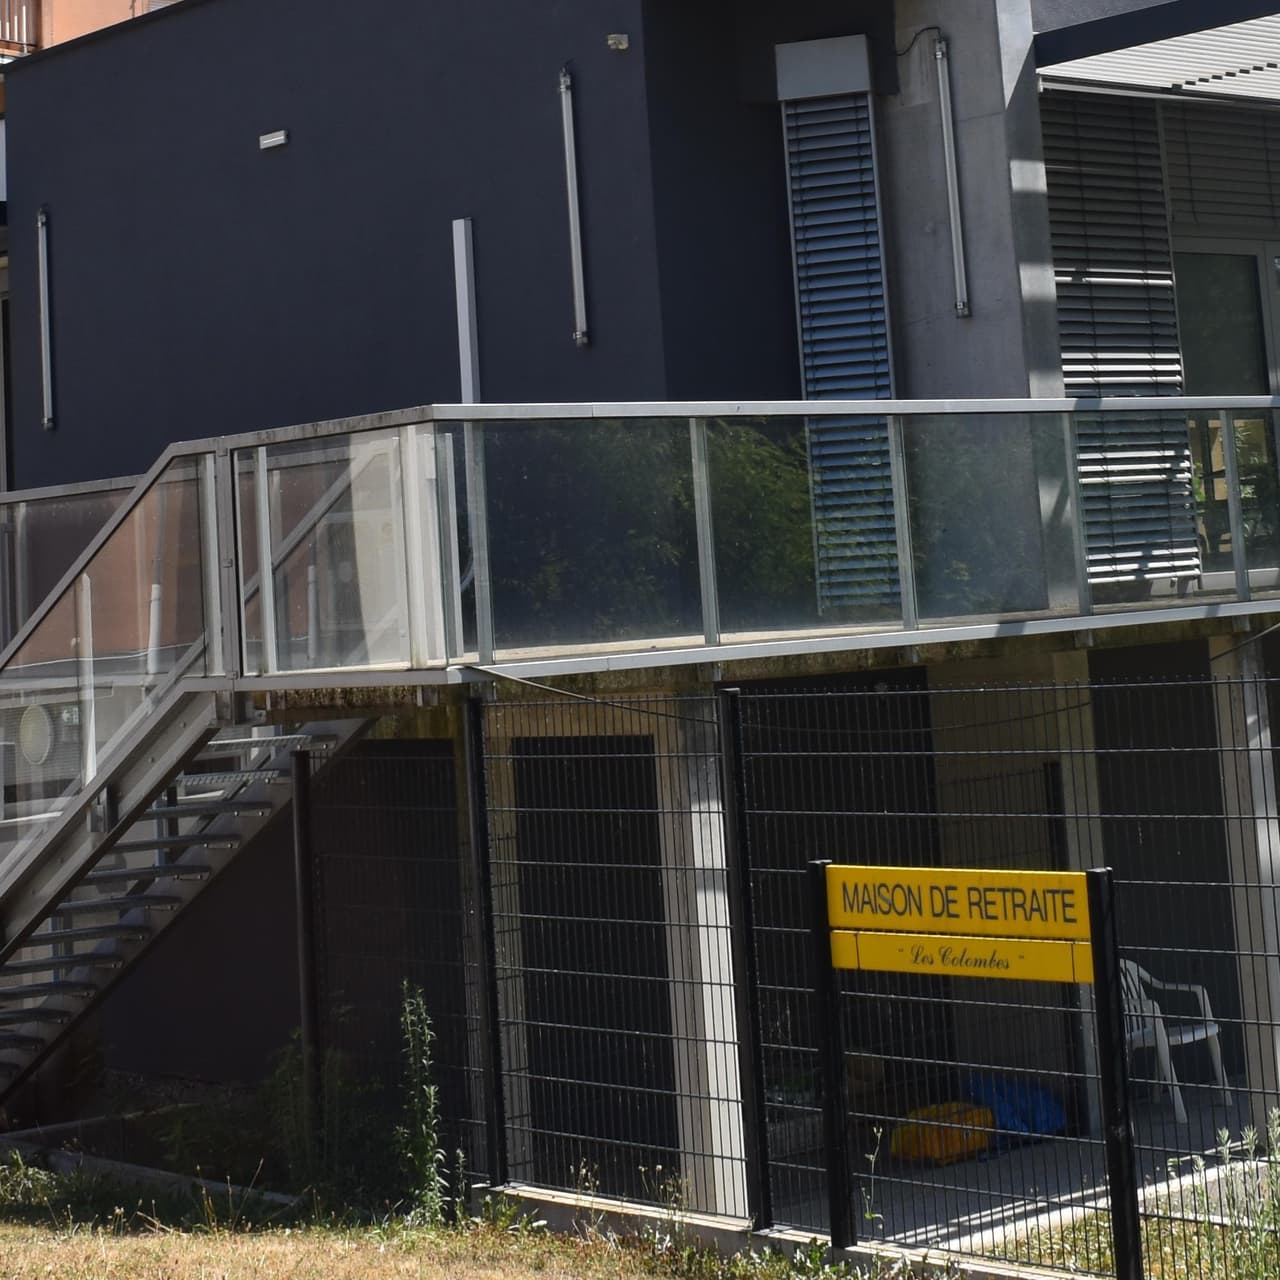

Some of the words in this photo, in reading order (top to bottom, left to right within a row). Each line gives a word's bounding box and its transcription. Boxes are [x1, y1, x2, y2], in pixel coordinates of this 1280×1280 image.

[842, 881, 923, 916] MAISON
[929, 885, 960, 918] DE
[967, 887, 1077, 923] RETRAITE
[911, 944, 934, 966] Les
[938, 945, 1010, 970] Colombes
